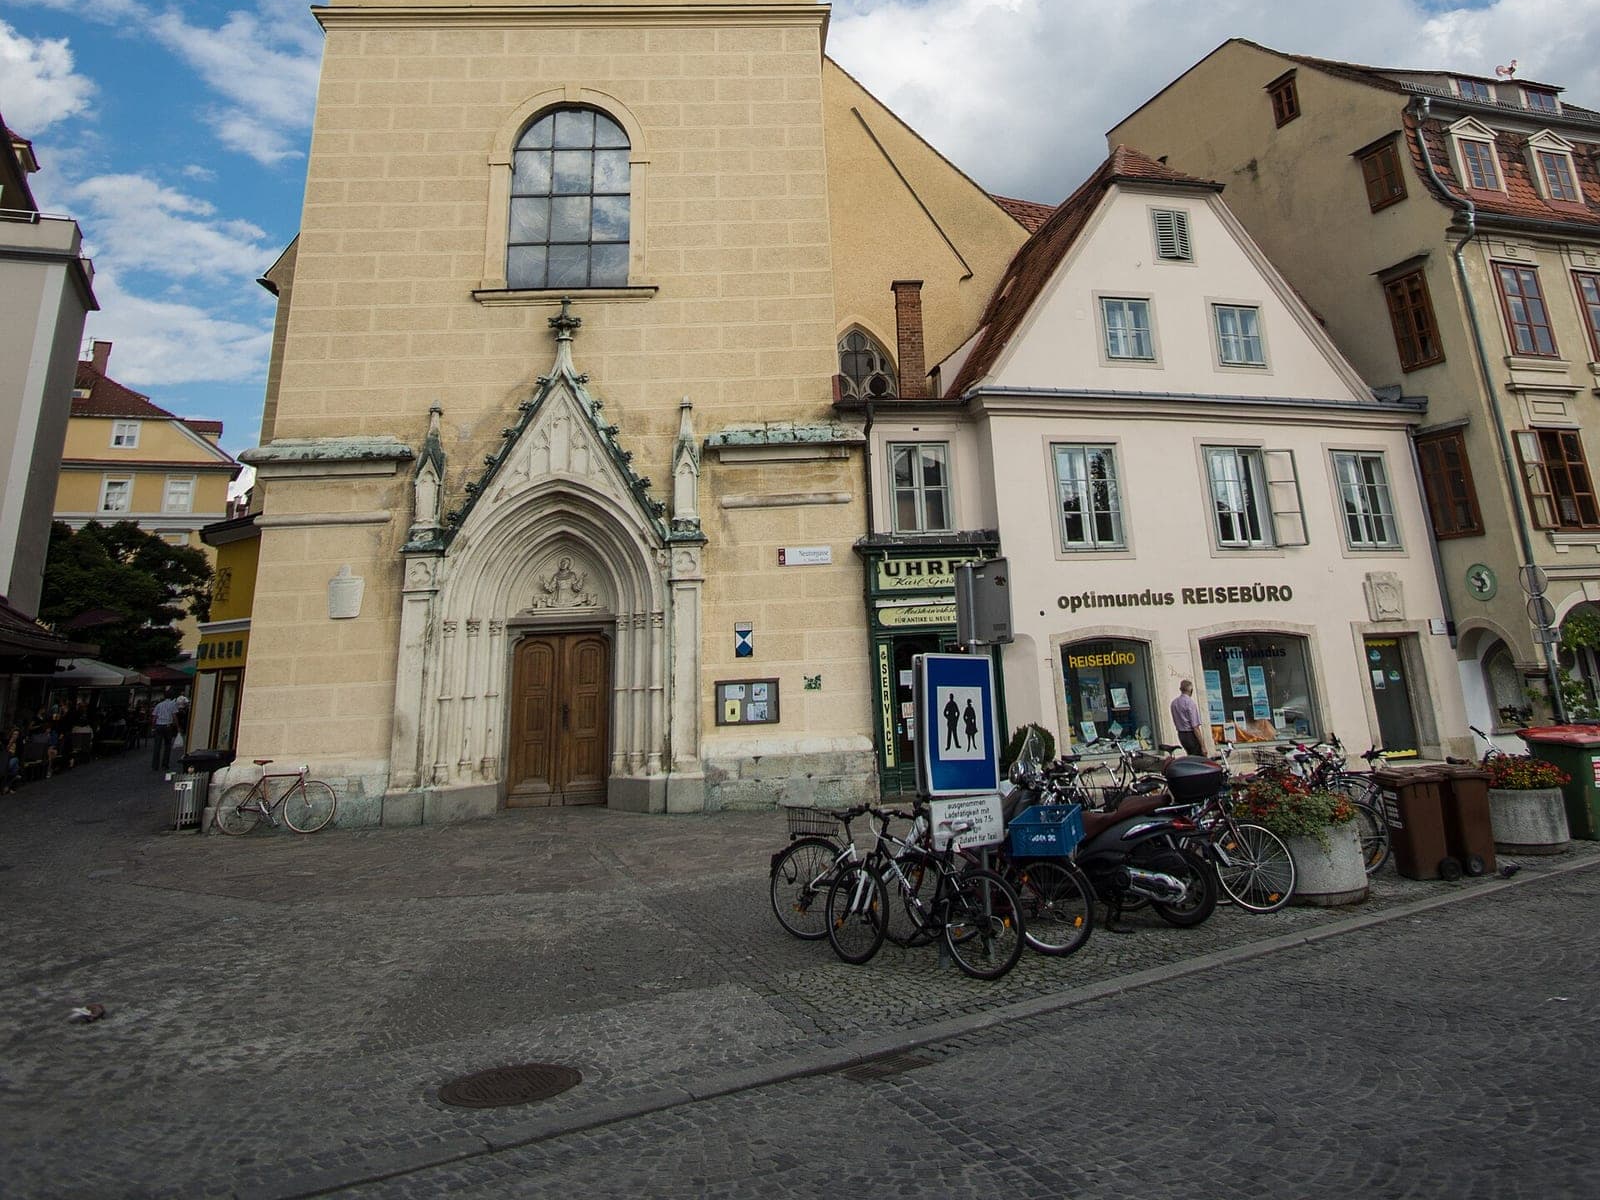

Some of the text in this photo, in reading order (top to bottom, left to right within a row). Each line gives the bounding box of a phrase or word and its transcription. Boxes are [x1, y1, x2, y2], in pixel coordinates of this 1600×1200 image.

[884, 560, 962, 577] UHRE
[1057, 583, 1293, 613] optimundus REISEBÜRO
[1068, 651, 1136, 668] REISEBÜRO
[881, 663, 893, 756] SERVICE
[947, 800, 986, 810] ausgenommen
